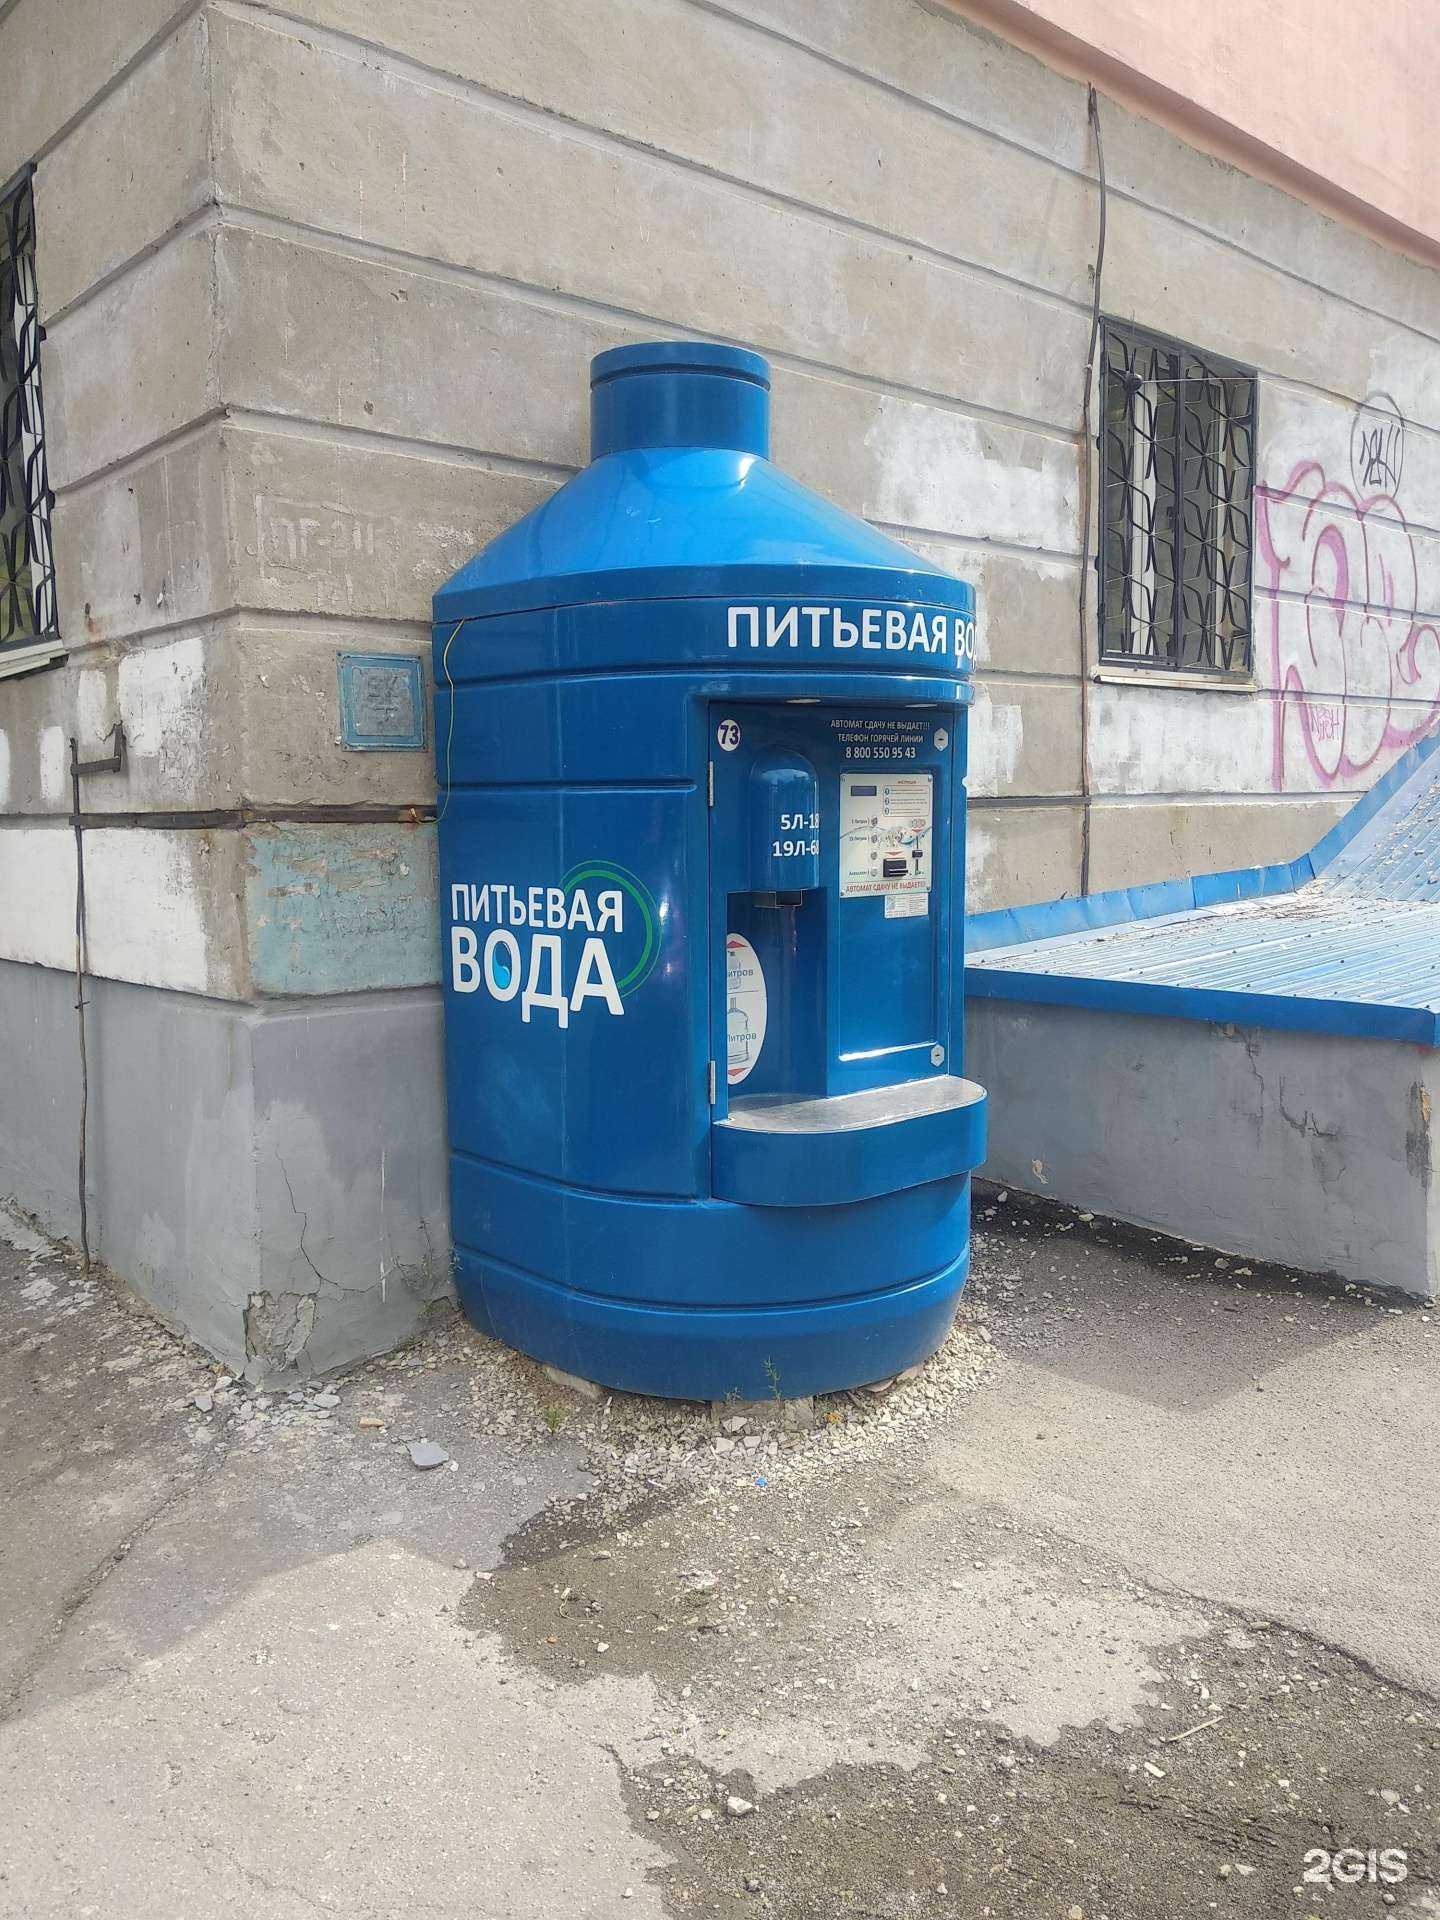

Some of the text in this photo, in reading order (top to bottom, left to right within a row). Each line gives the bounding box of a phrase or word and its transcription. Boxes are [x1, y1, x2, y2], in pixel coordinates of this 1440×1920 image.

[727, 606, 947, 654] ПИТЬЕВАЯ
[830, 719, 930, 731] АВТОМАТ СДАЧУ НЕ ВЫДАЕТ!!!
[720, 724, 739, 745] 73
[837, 732, 924, 744] ТЕЛЕФОН ГОРЯЧЕЙ ЛИНИИ
[845, 746, 916, 759] 8 800 550 95 43
[846, 883, 872, 893] АВТОМАТ
[451, 883, 623, 933] ПИТЬЕВАЯ
[450, 926, 625, 1029] ВОДА
